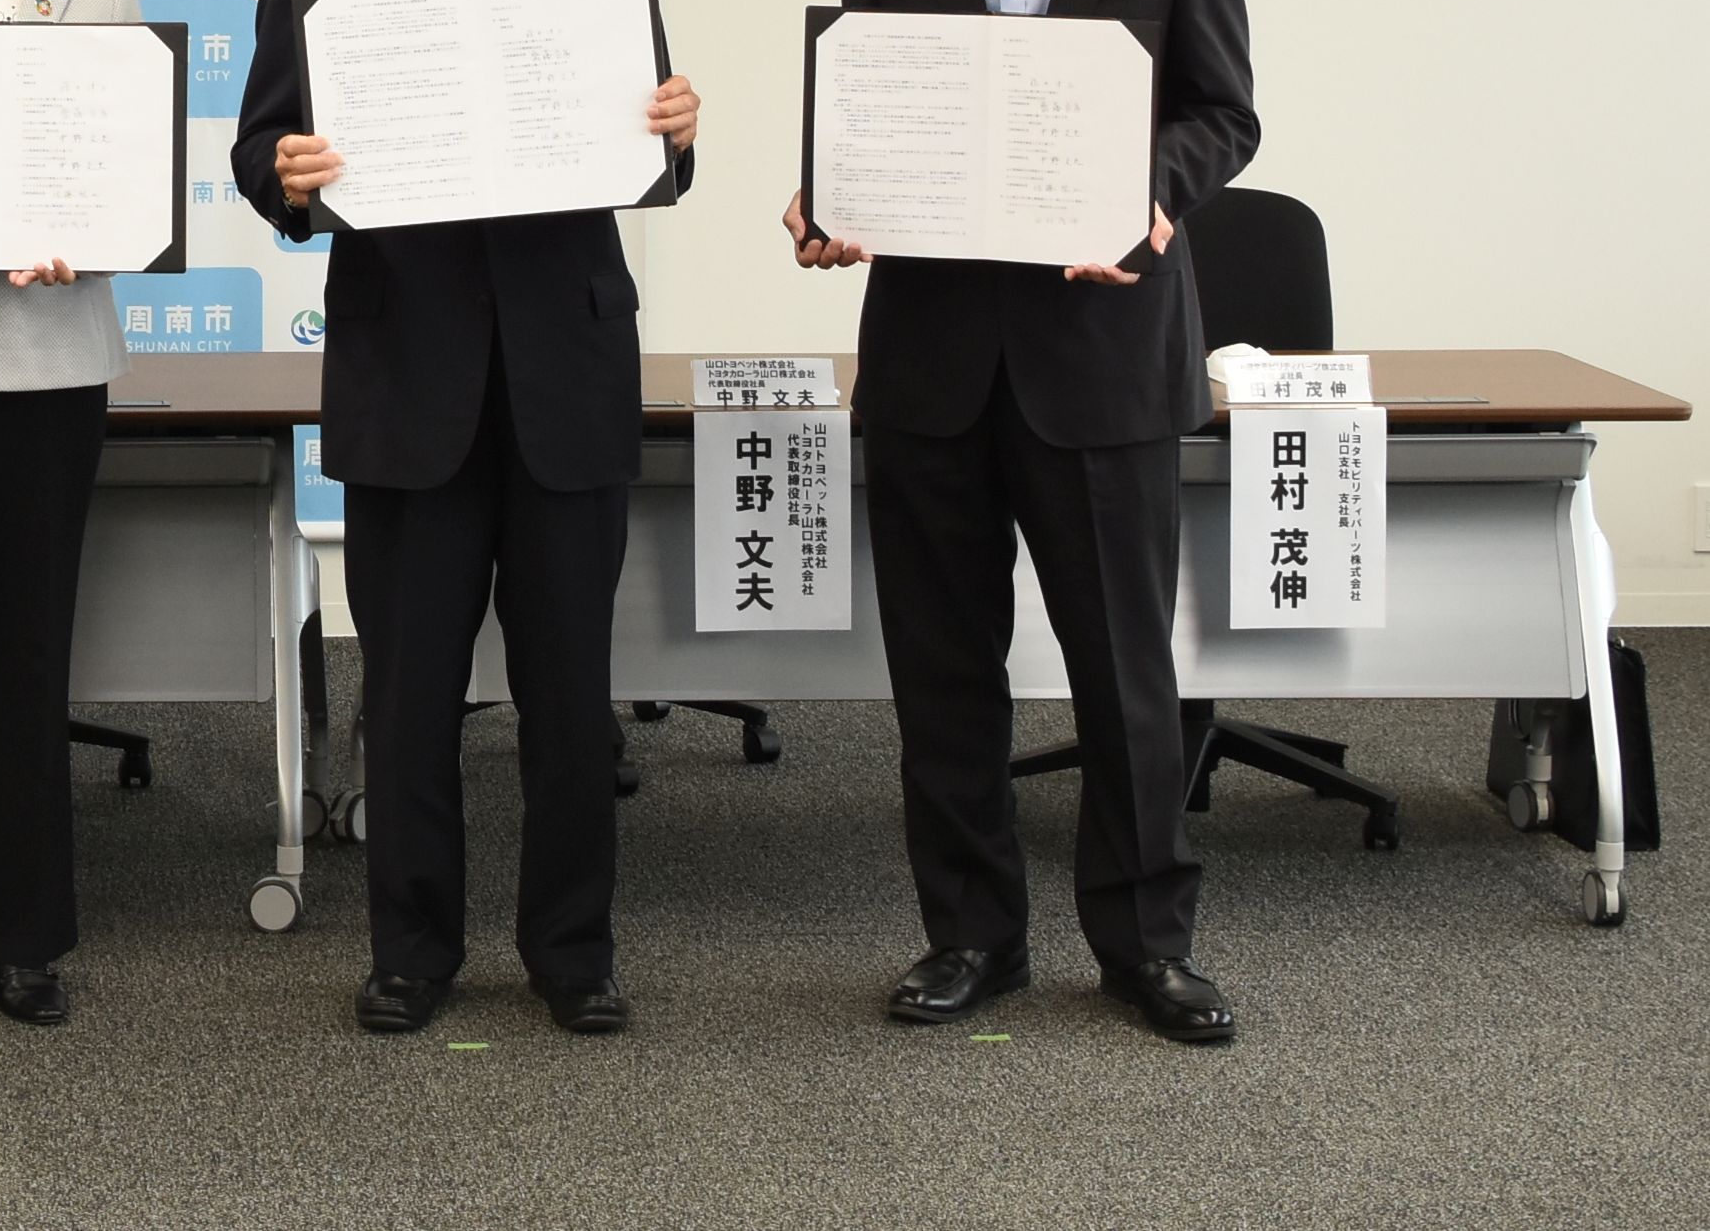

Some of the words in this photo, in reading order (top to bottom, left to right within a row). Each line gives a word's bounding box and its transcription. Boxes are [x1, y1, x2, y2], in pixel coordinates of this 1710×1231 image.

[195, 70, 231, 81] CITY
[125, 304, 233, 334] 周南市
[127, 341, 189, 353] SHUNAN
[197, 341, 232, 352] CITY
[708, 379, 765, 388] 代表取締役社長
[736, 431, 775, 512] 中野
[787, 433, 800, 526] 代表取締役社長
[801, 424, 814, 596] トヨタカローラ山口株式会社
[814, 422, 828, 569] 山口トヨペット株式会社
[1270, 431, 1309, 511] 田村
[1350, 421, 1362, 601] トヨタモビリティパーツ株式会社
[735, 530, 774, 611] 文夫
[1270, 528, 1309, 609] 茂伸
